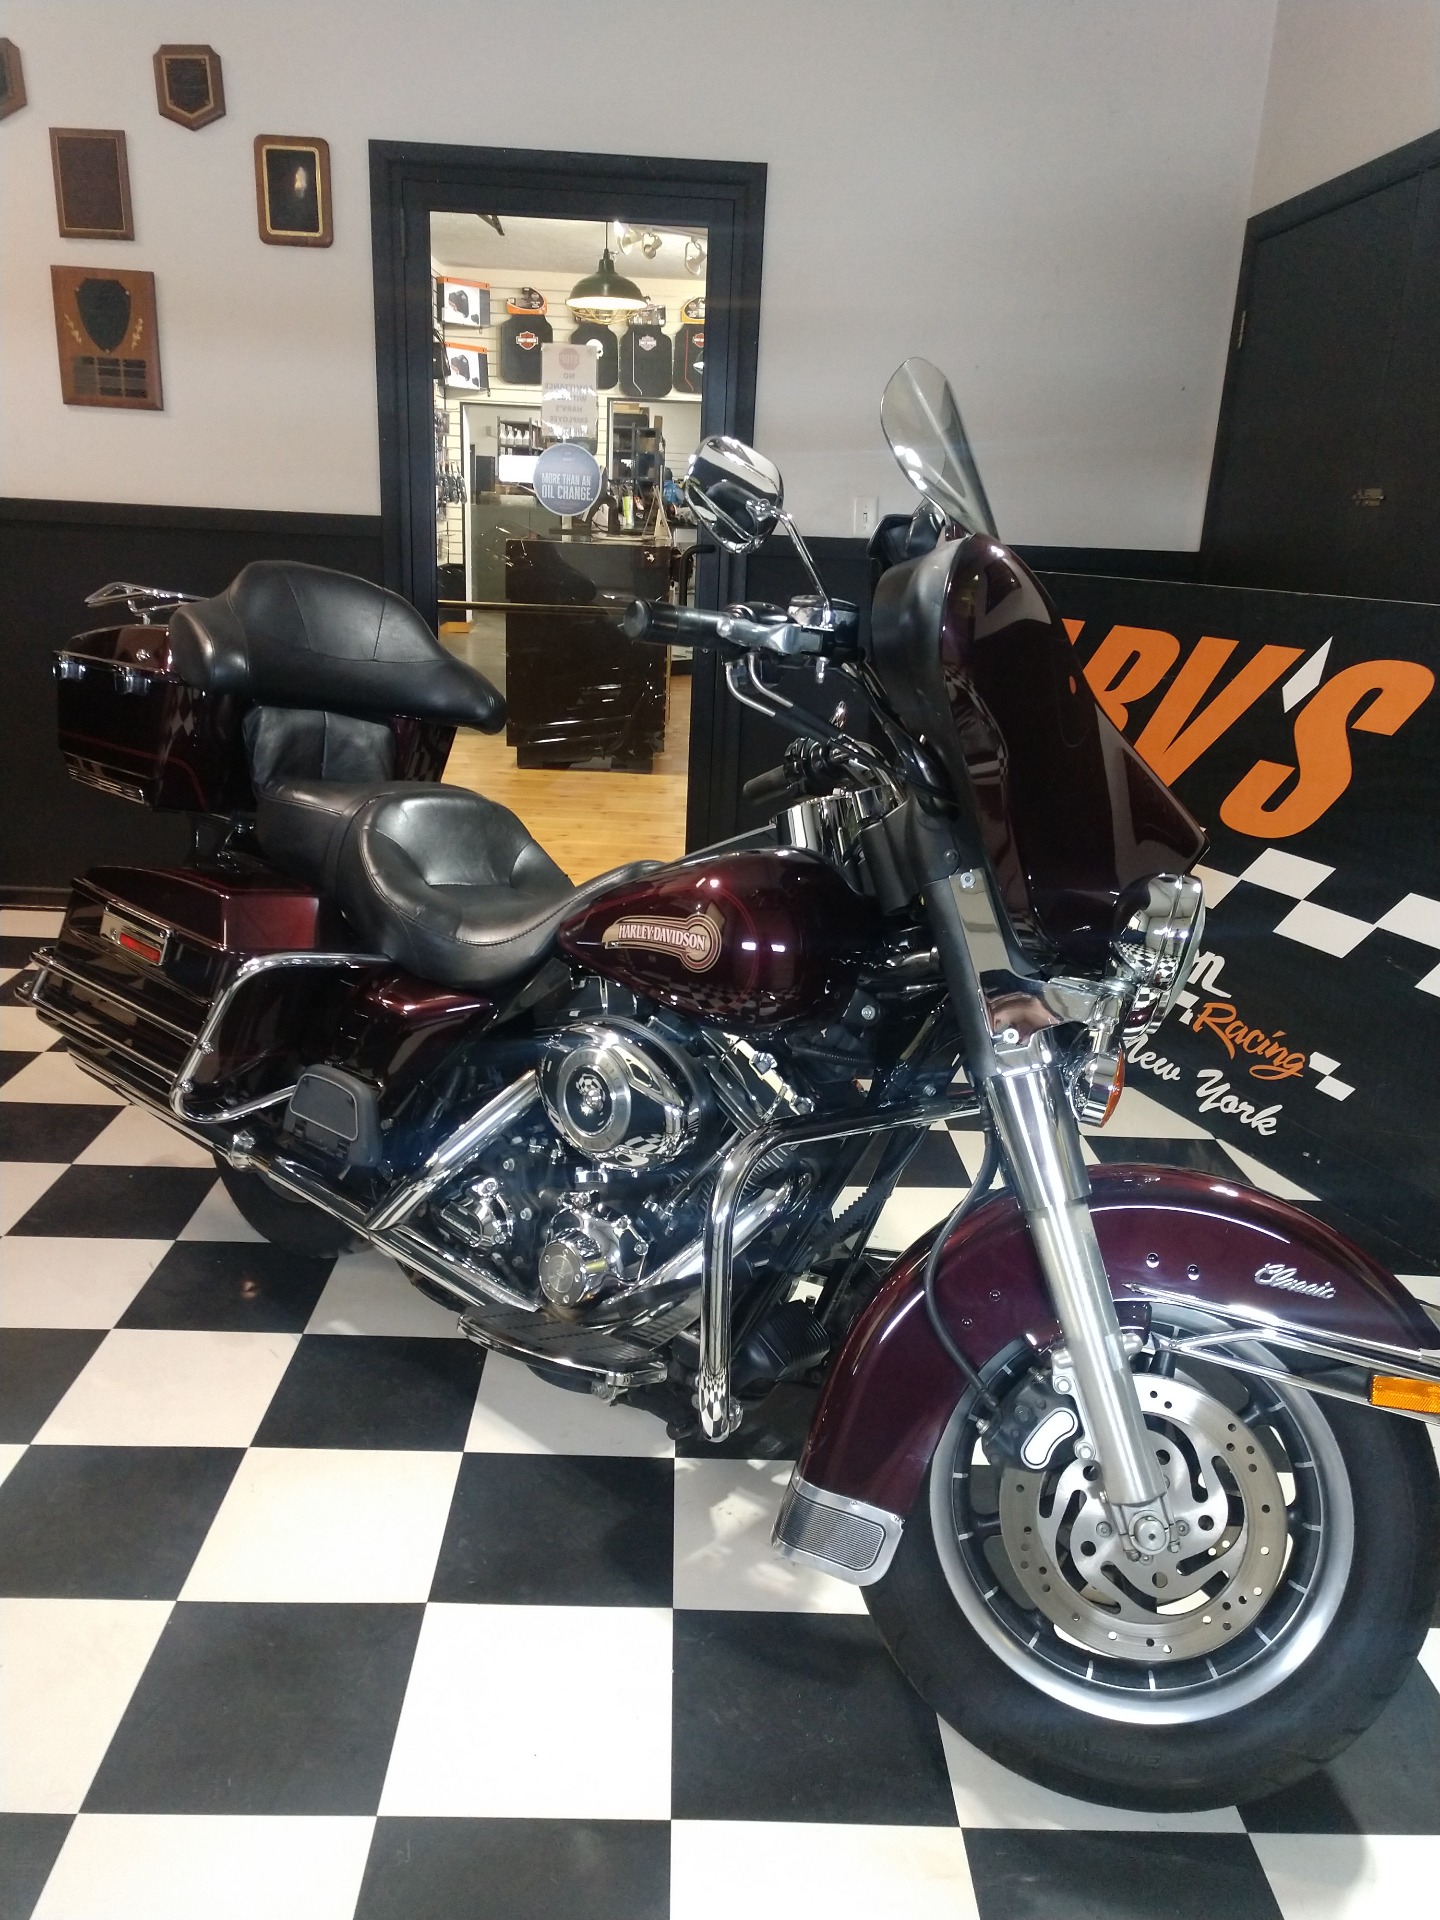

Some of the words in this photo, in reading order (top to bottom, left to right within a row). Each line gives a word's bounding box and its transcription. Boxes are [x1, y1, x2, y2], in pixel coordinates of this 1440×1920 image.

[541, 472, 561, 485] MORE
[562, 473, 580, 486] THAN
[581, 474, 592, 487] AN
[541, 484, 555, 499] OIL
[557, 485, 594, 501] CHANGE.
[1062, 618, 1436, 838] RV'S
[618, 924, 706, 951] HARLEY-DAVIDSON
[1192, 1002, 1306, 1081] Racing
[1195, 1069, 1283, 1136] York
[1254, 1262, 1337, 1300] Classic
